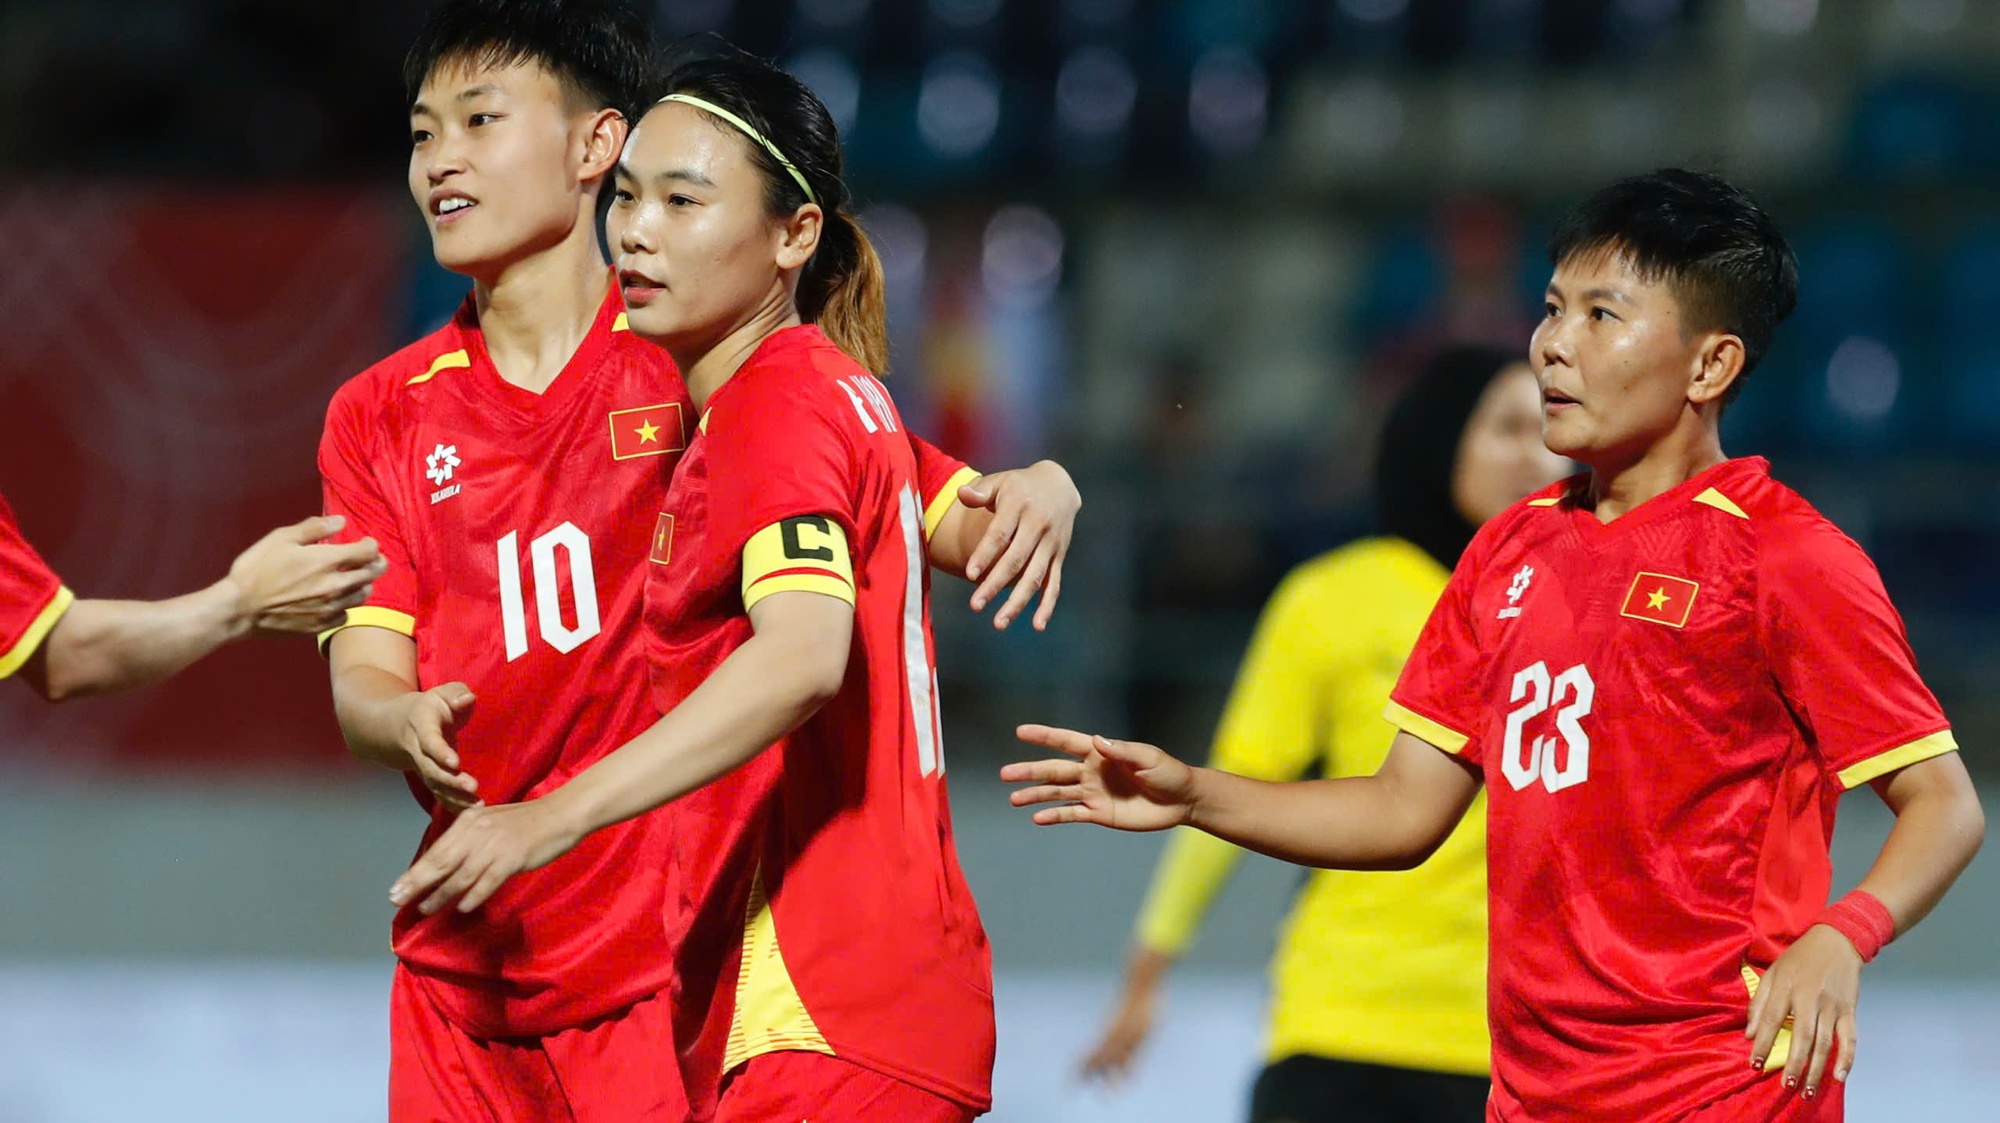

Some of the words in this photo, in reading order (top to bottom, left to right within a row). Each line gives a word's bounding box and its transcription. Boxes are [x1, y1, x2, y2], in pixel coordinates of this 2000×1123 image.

[497, 521, 601, 663] 10
[780, 514, 833, 562] C
[1501, 661, 1596, 794] 23
